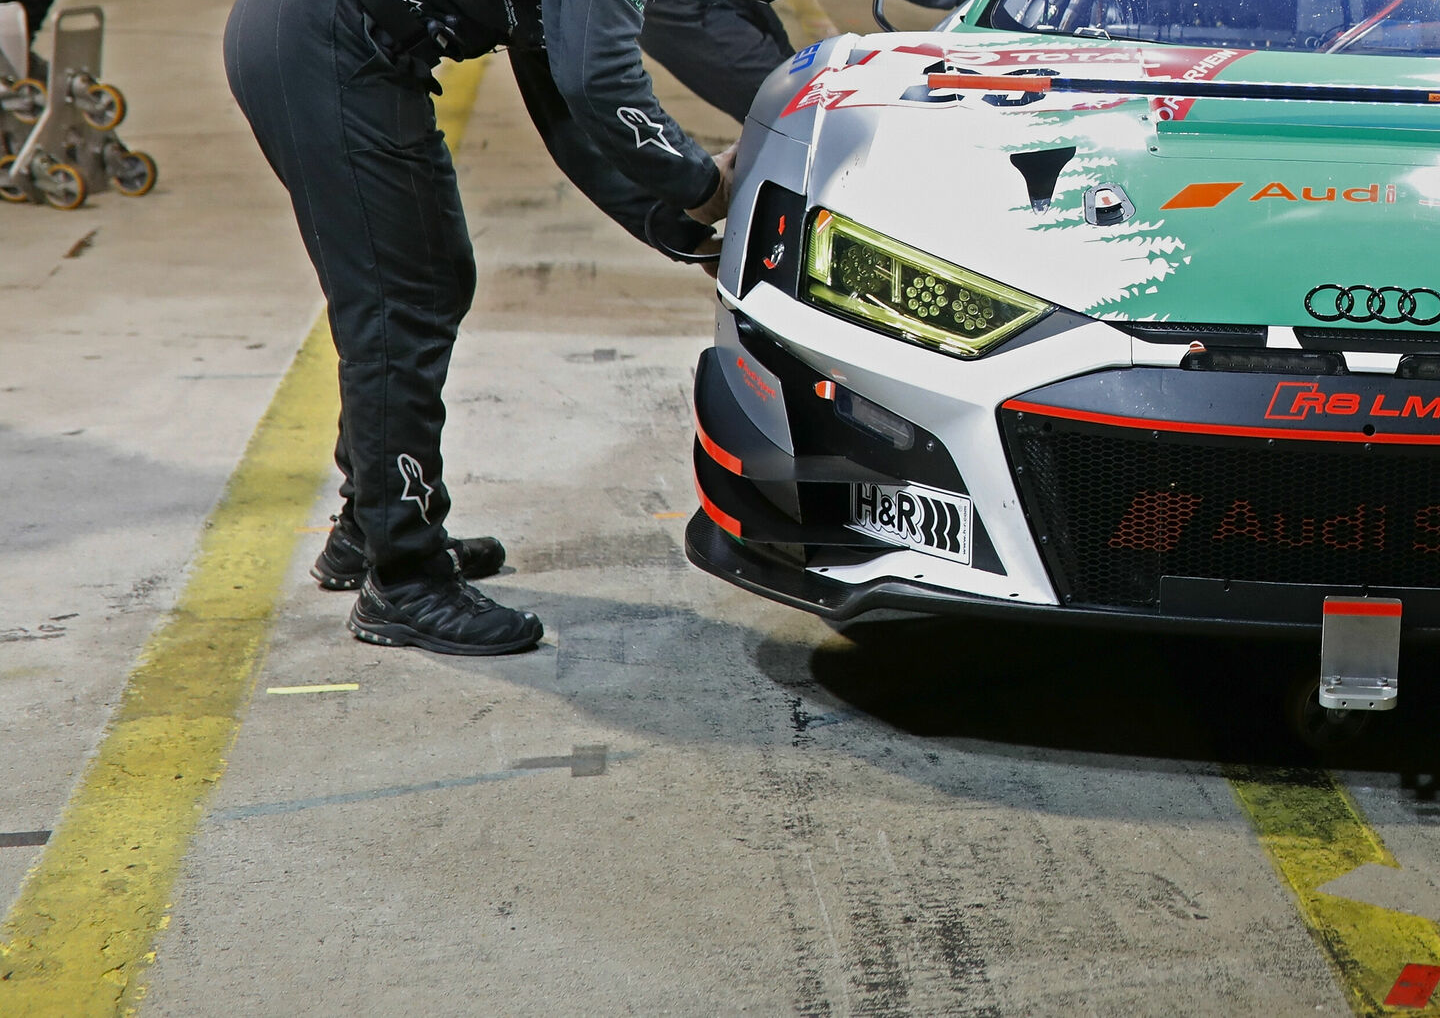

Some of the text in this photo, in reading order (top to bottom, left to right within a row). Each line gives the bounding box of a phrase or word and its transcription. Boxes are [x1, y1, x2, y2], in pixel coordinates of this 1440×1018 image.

[1010, 52, 1131, 63] TOTA
[1248, 182, 1396, 204] Audi
[1288, 390, 1360, 419] R8
[856, 481, 918, 537] H&R
[1211, 498, 1387, 551] Audi
